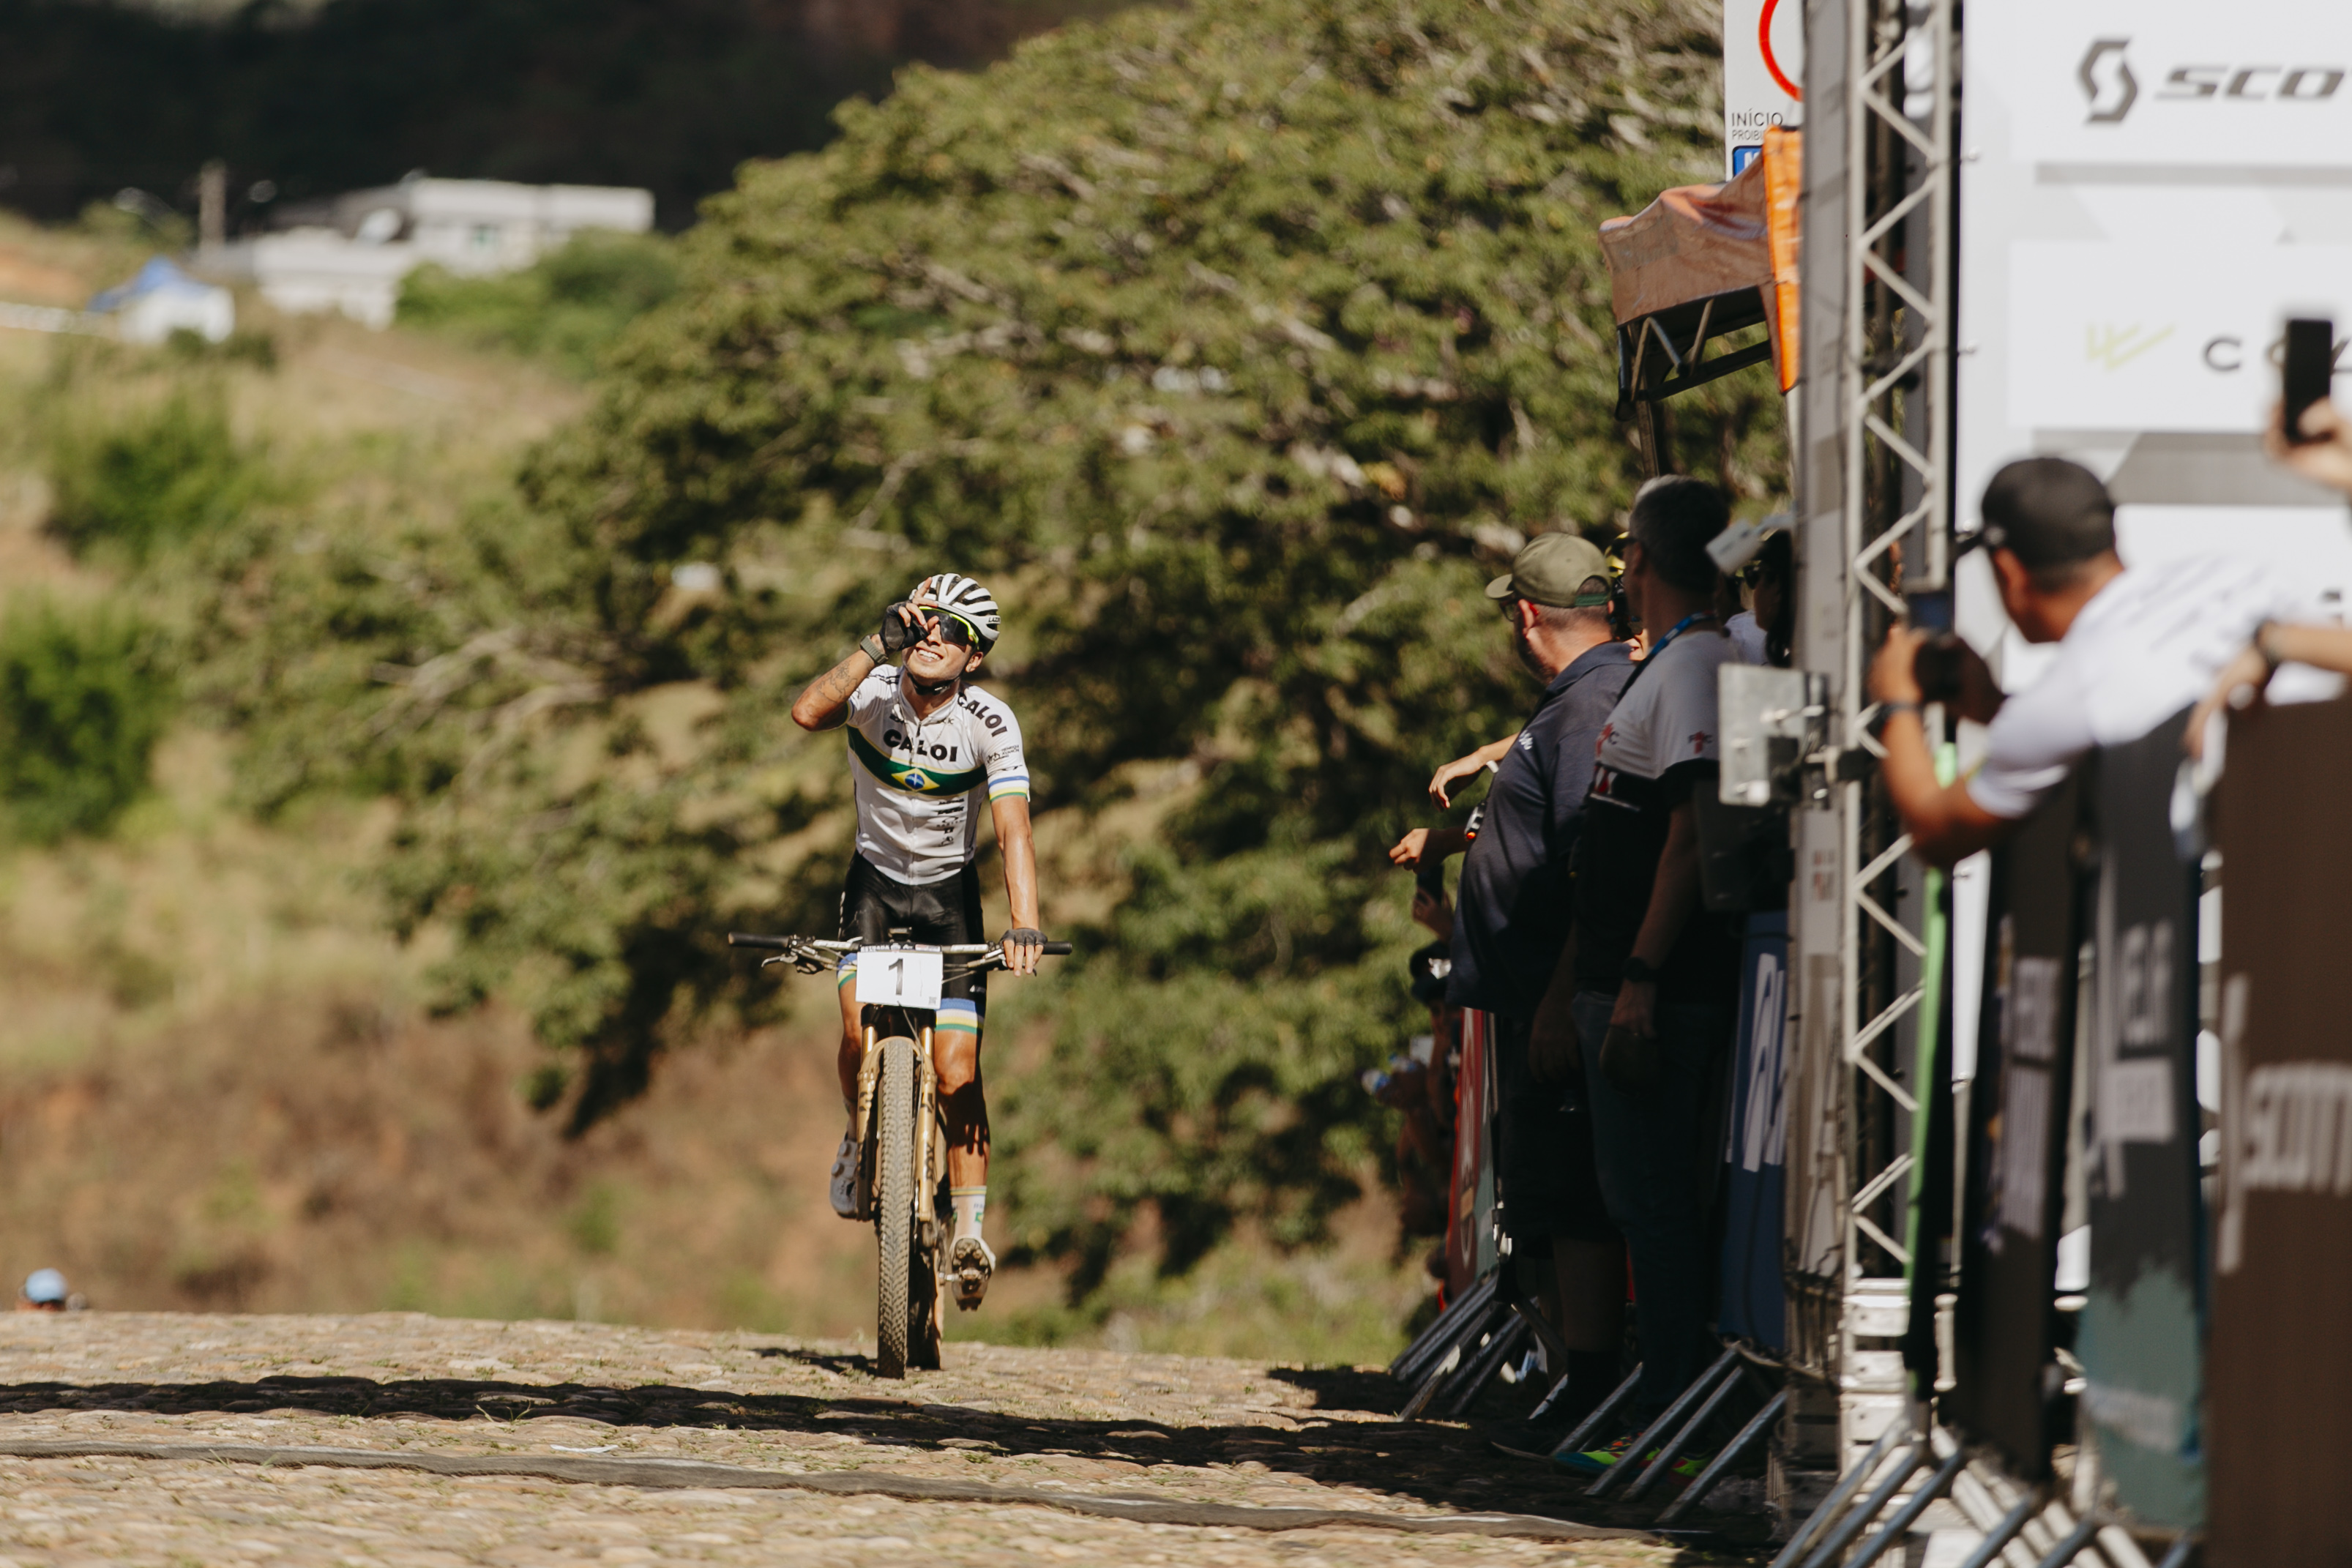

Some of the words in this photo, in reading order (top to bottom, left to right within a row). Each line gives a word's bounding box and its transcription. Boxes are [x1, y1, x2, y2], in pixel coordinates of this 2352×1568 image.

[2154, 64, 2352, 100] SCO
[1732, 108, 1783, 127] INÍCIO
[957, 692, 1008, 737] CALOI
[884, 729, 958, 762] CALOI
[888, 957, 903, 996] 1
